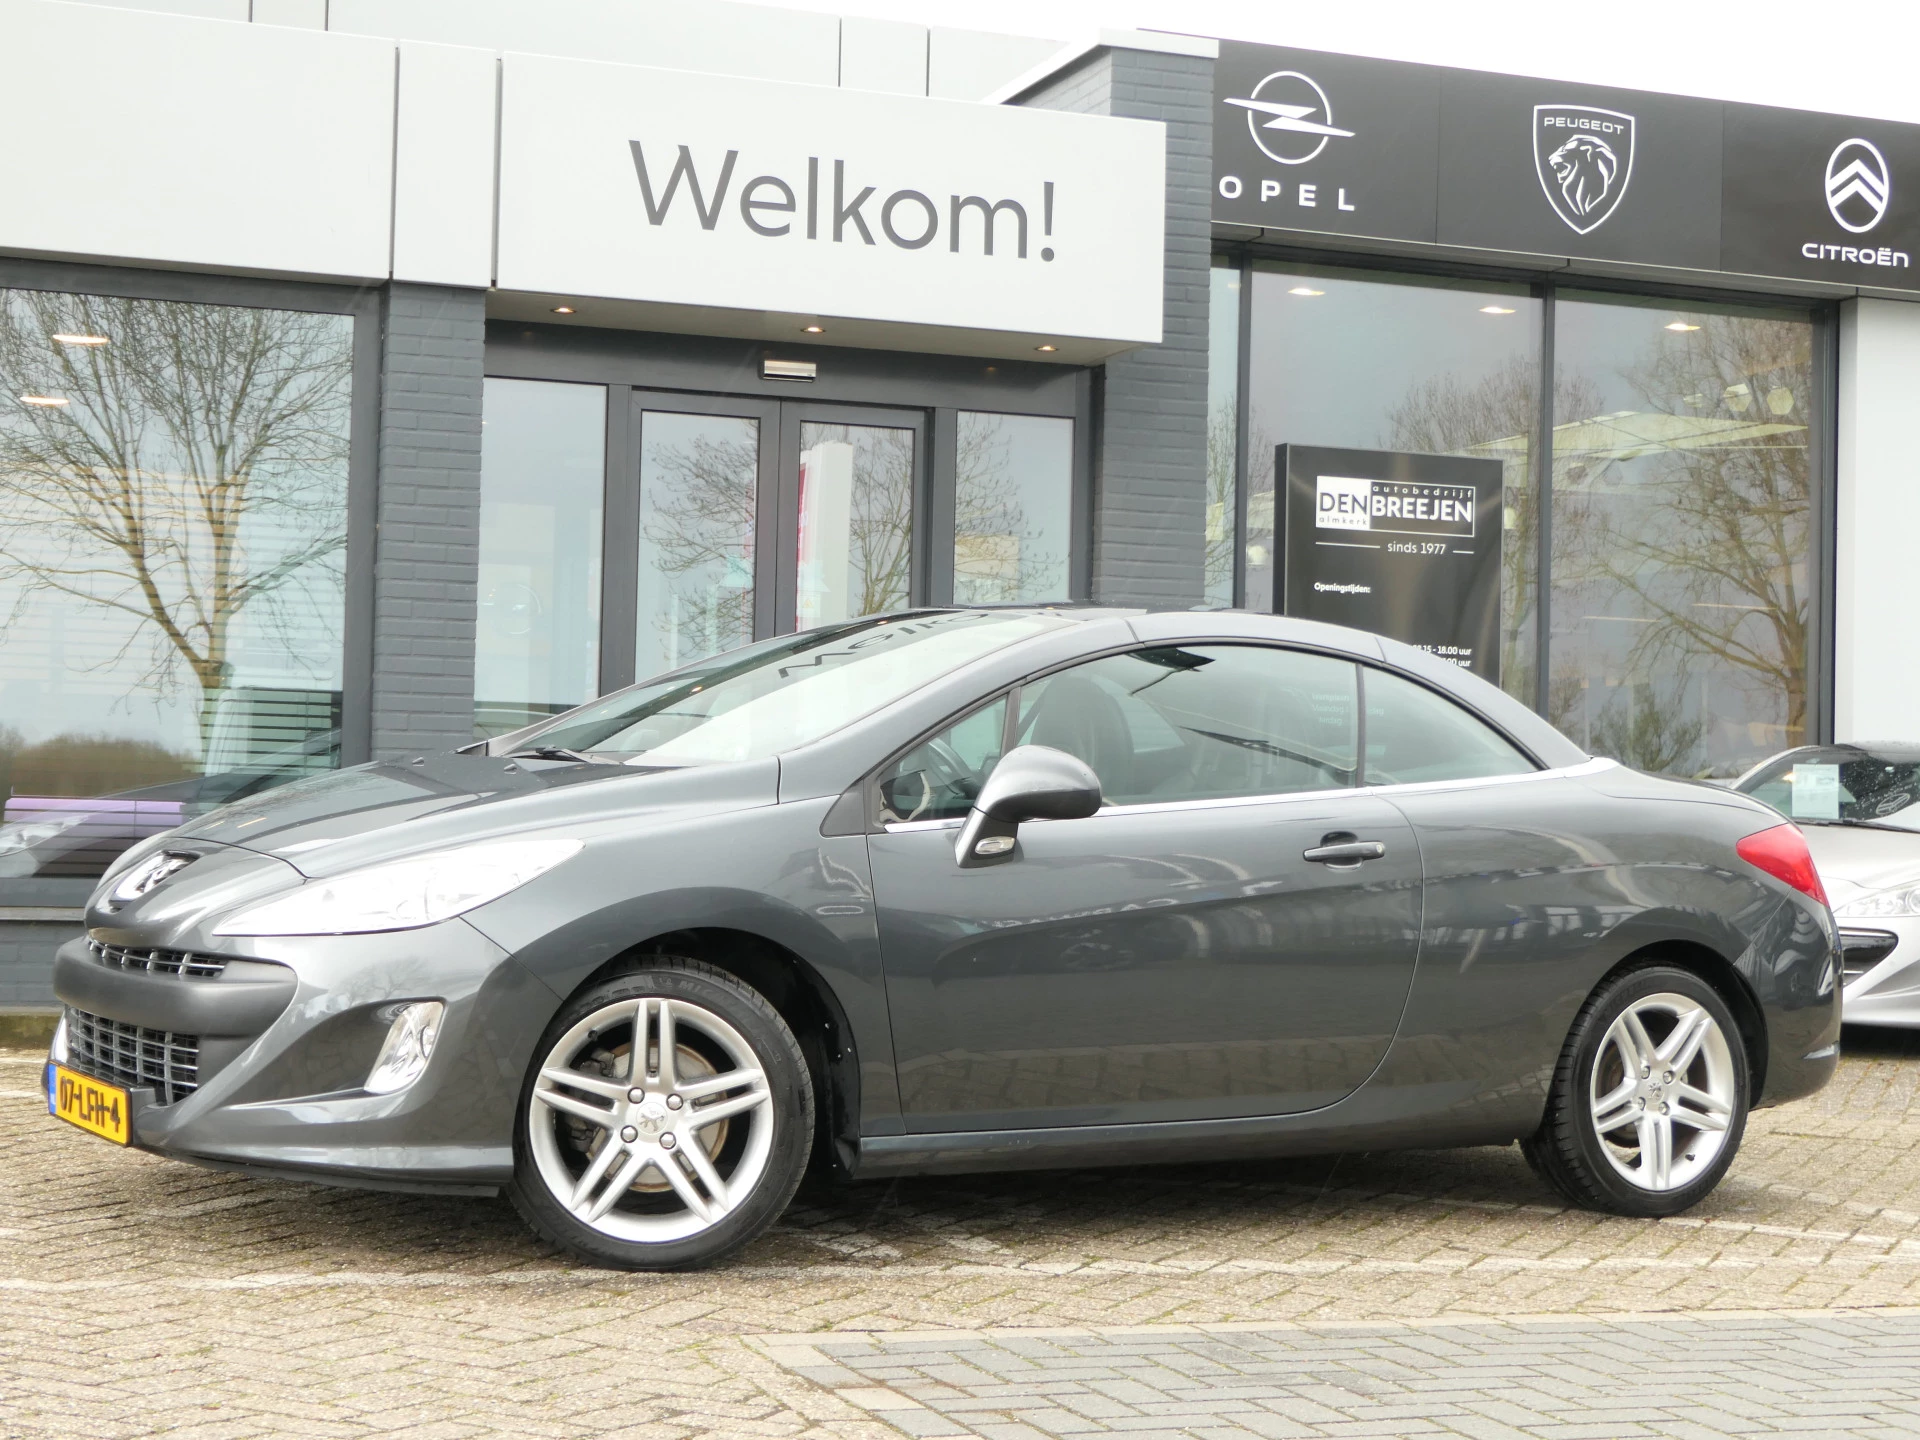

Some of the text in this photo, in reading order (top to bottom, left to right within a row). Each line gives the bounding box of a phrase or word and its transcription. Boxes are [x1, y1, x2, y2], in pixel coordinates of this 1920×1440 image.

[1544, 116, 1625, 136] PEUGEOT
[628, 139, 1056, 263] Welkom!
[1218, 175, 1356, 212] OPEL
[1372, 485, 1473, 499] autobedrijf
[1319, 492, 1473, 523] DEN BREEJEN
[1318, 515, 1368, 526] almkerk
[1387, 541, 1447, 555] sinds 1977
[1313, 581, 1371, 595] Openingstijden:
[1437, 645, 1458, 655] 18.00
[1459, 648, 1472, 656] uur
[60, 1075, 121, 1133] 07-LFH-4
